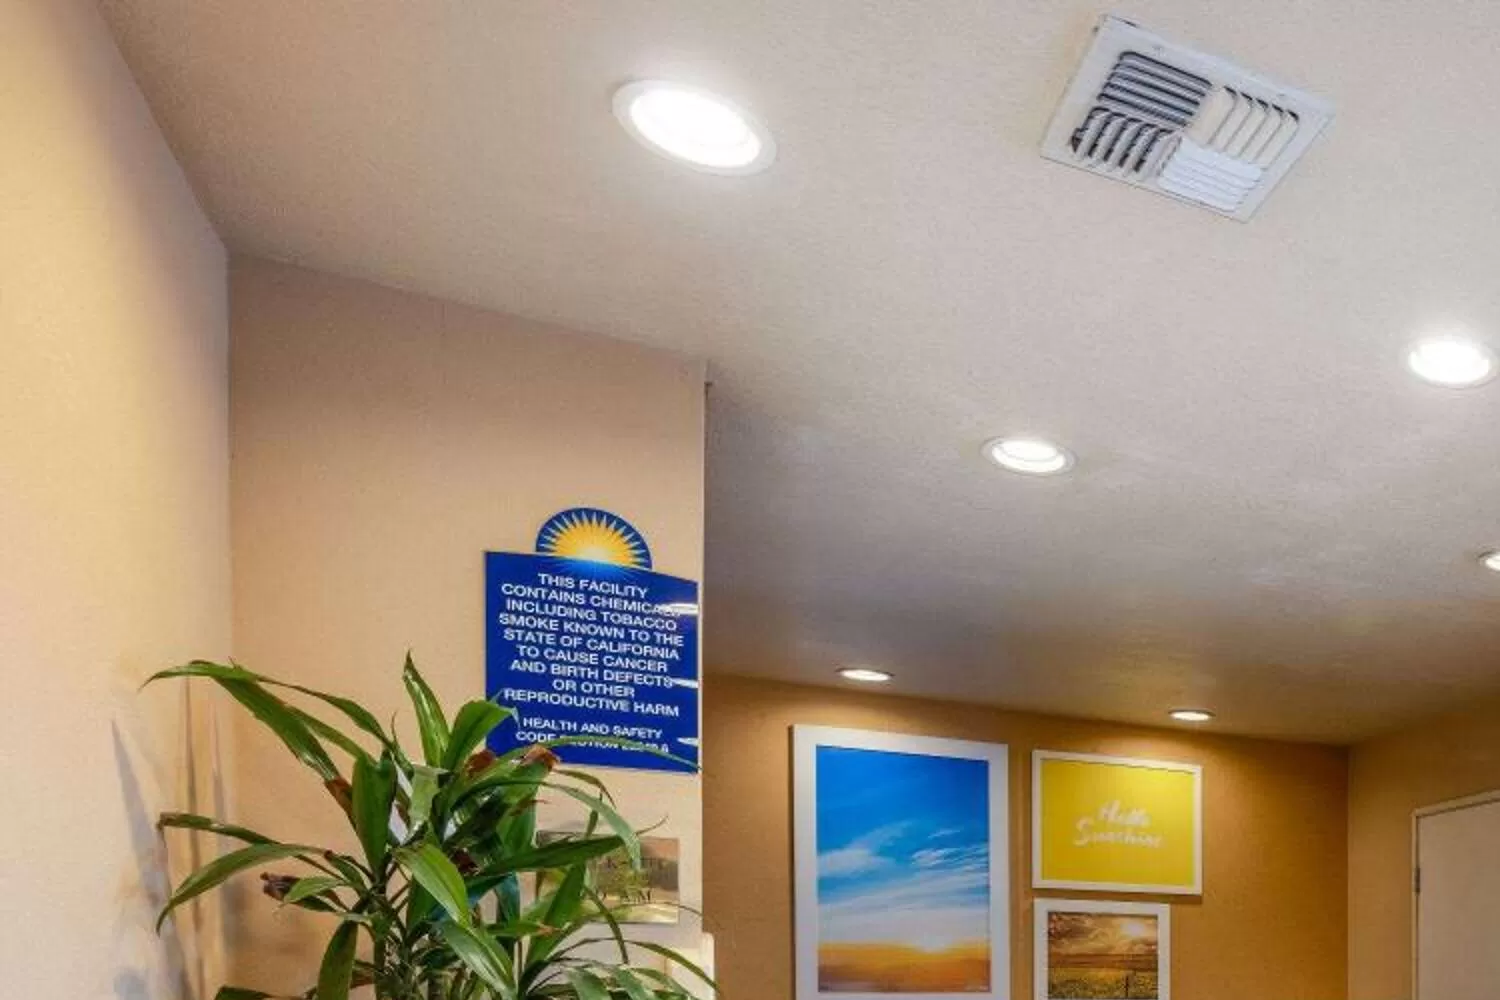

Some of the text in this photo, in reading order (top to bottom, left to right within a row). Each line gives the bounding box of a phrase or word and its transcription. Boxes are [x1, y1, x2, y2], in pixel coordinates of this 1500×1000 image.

[501, 583, 586, 605] CONTAINS
[537, 573, 648, 598] THIS FACILITY
[506, 598, 677, 631] INCLUDING TOBACCO
[499, 613, 684, 647] SMOKE KNOWN TO THE
[503, 628, 680, 660] STATE OF CALIFORNIA
[516, 645, 667, 672] TO CAUSE CANCER
[509, 659, 673, 689] AND BIRTH DEFECTS
[503, 687, 679, 717] REPRODUCTIVE HARM
[552, 679, 635, 698] OR OTHER
[523, 717, 663, 739] HEALTH AND SAFETY
